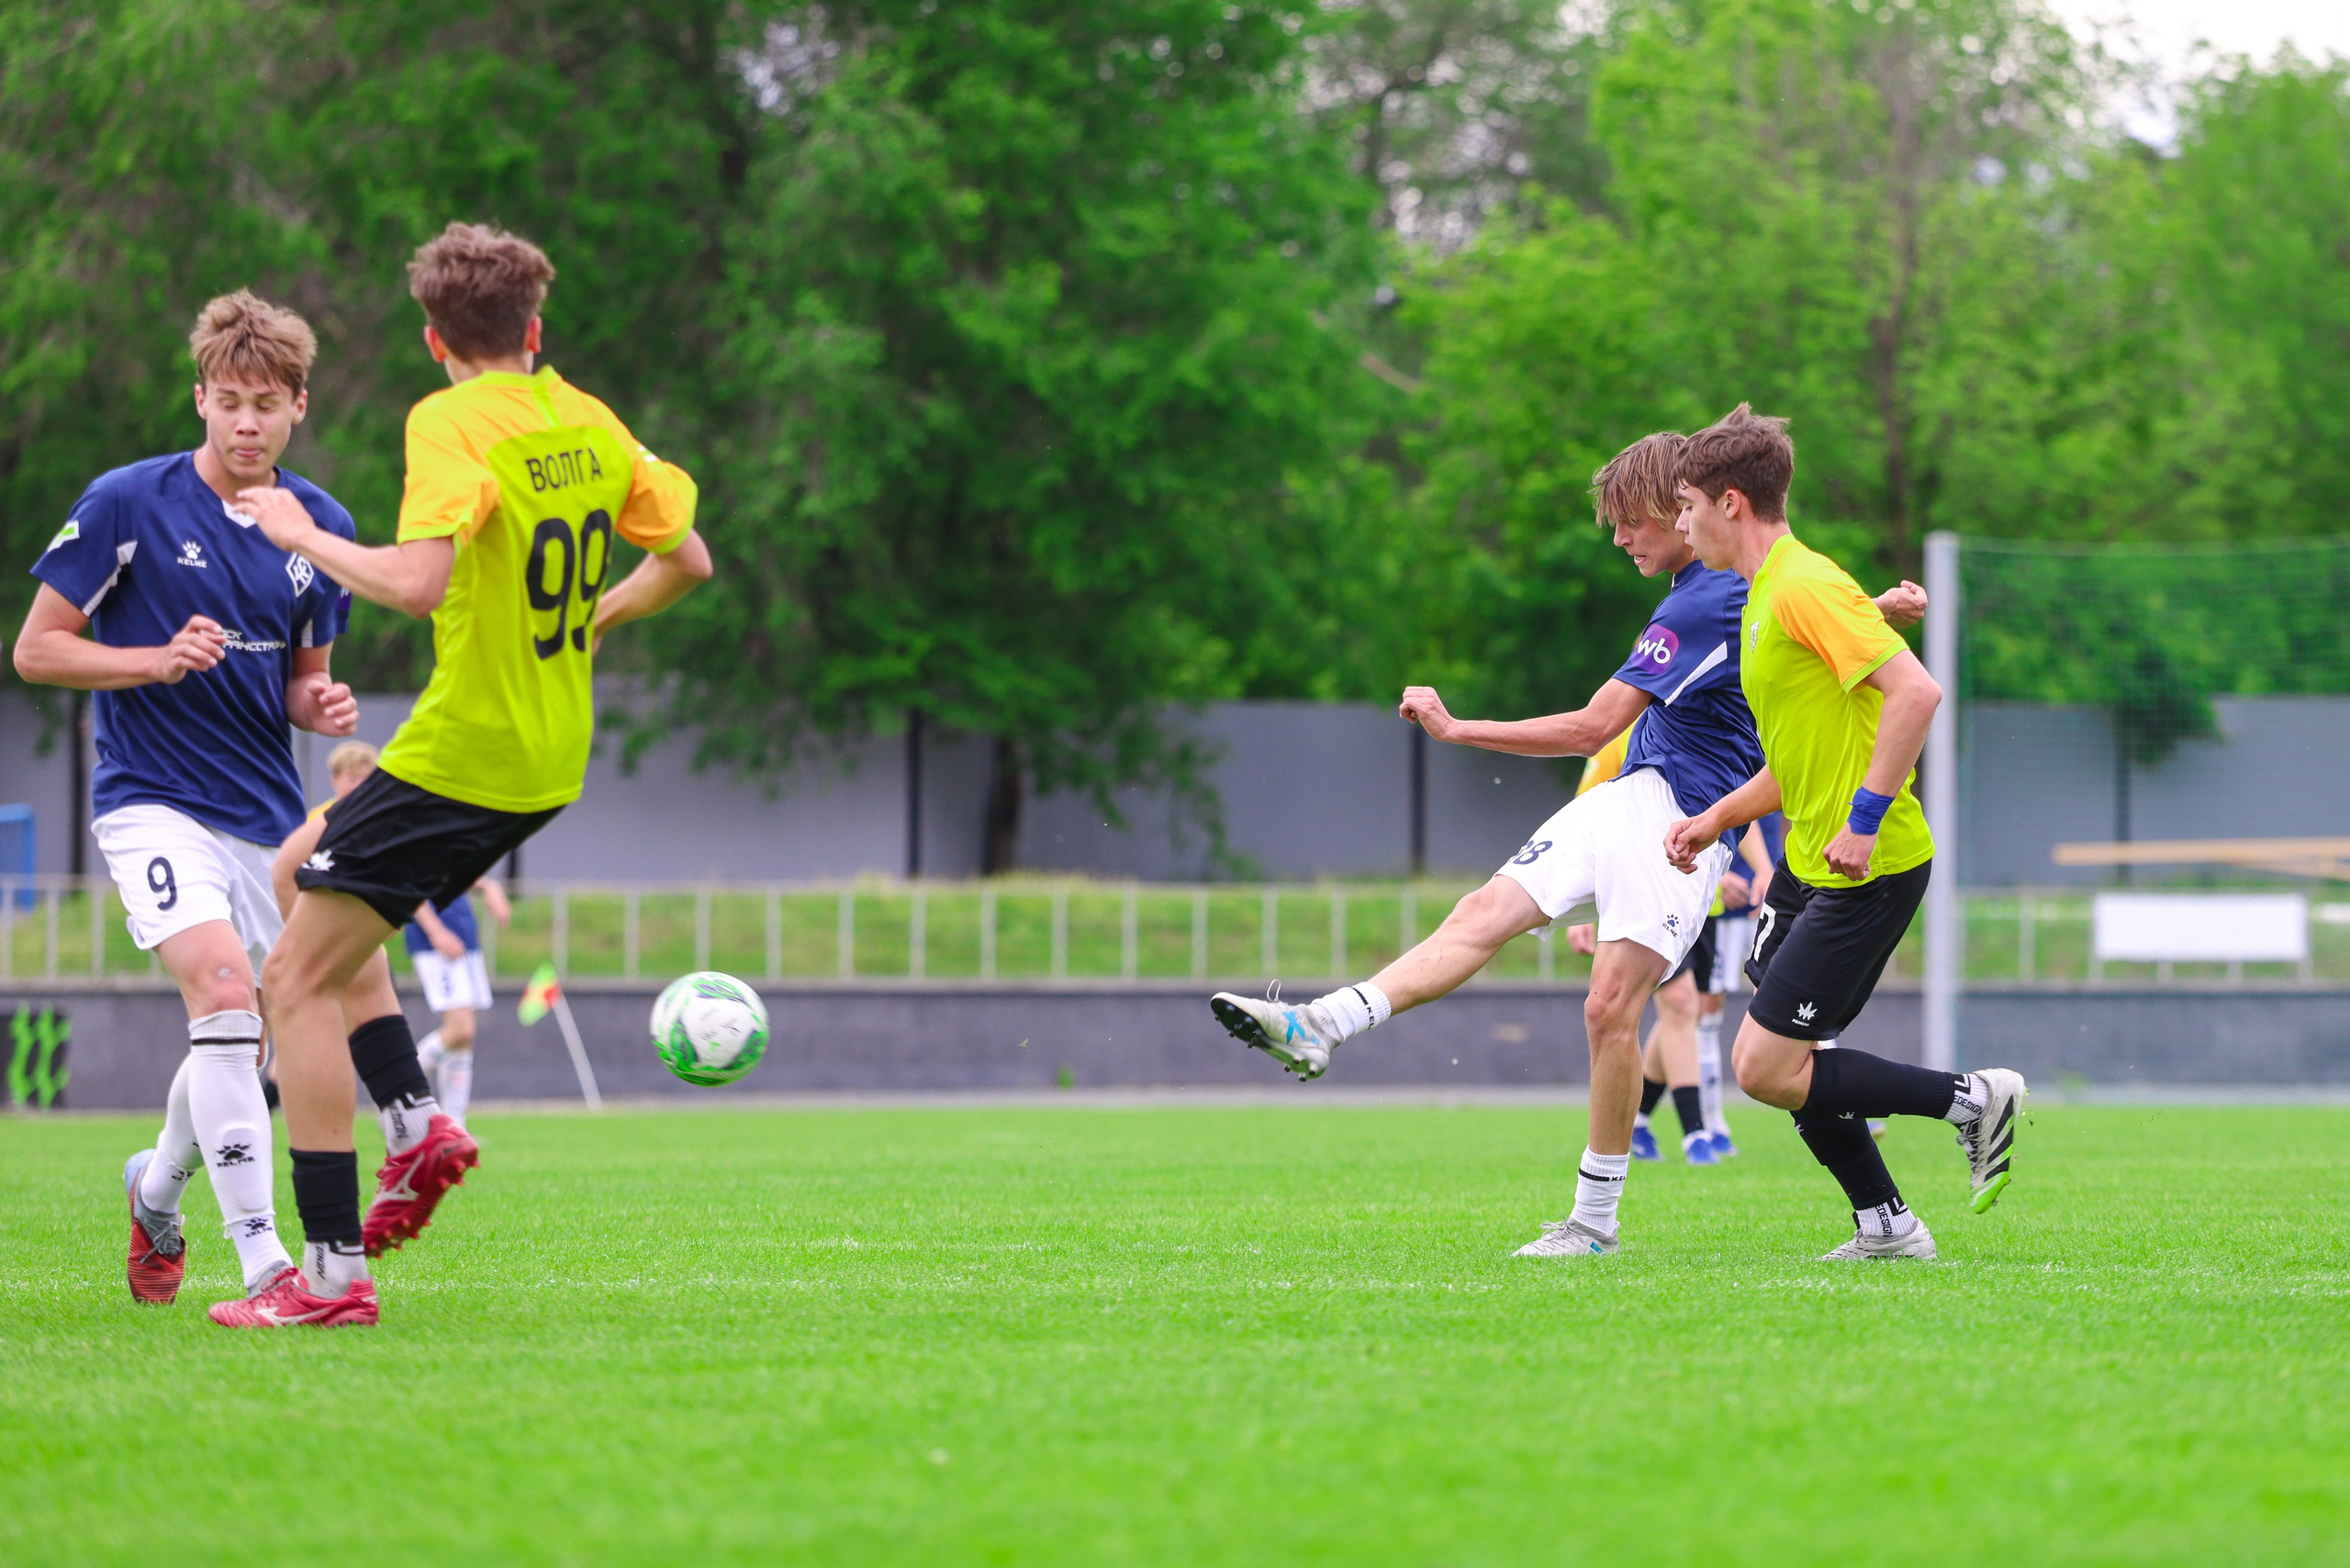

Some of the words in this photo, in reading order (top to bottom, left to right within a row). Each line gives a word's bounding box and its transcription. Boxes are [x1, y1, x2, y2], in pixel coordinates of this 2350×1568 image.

[525, 447, 603, 492] ВОЛГА
[176, 556, 207, 568] KELME
[526, 509, 612, 661] 99
[1637, 637, 1672, 665] wb
[147, 857, 177, 911] 9
[1751, 901, 1776, 963] 7
[1953, 1094, 1985, 1115] EDESIGN
[217, 1156, 256, 1168] KELME
[1874, 1203, 1894, 1238] EDESIGN
